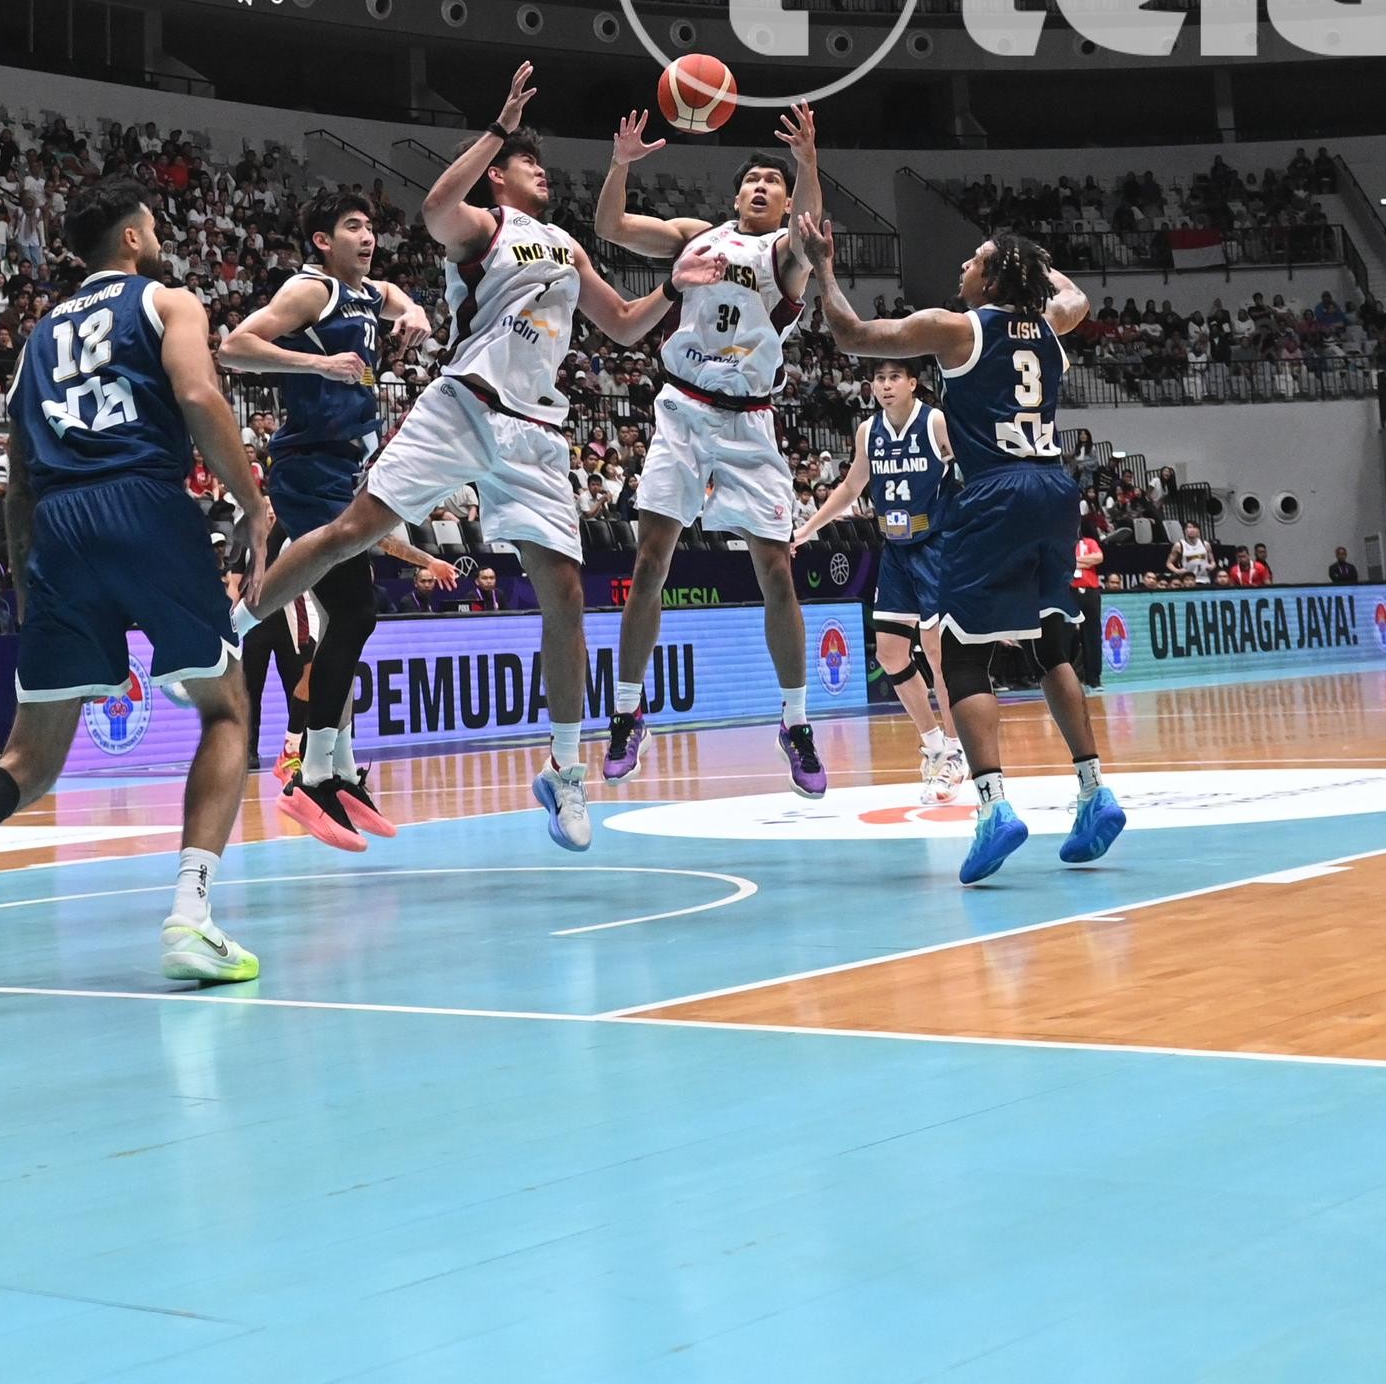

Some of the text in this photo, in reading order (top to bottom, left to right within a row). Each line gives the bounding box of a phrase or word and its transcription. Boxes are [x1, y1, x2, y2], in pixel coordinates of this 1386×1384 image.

[51, 282, 126, 319] BREUNIG
[716, 303, 741, 333] 34
[53, 307, 114, 383] 12
[1007, 320, 1042, 340] LISH
[1012, 349, 1044, 408] 3
[871, 456, 929, 475] THAILAND
[885, 479, 911, 502] 24
[1148, 597, 1292, 661] OLAHRAGA
[1296, 594, 1359, 650] JAYA!
[581, 643, 696, 721] MJU
